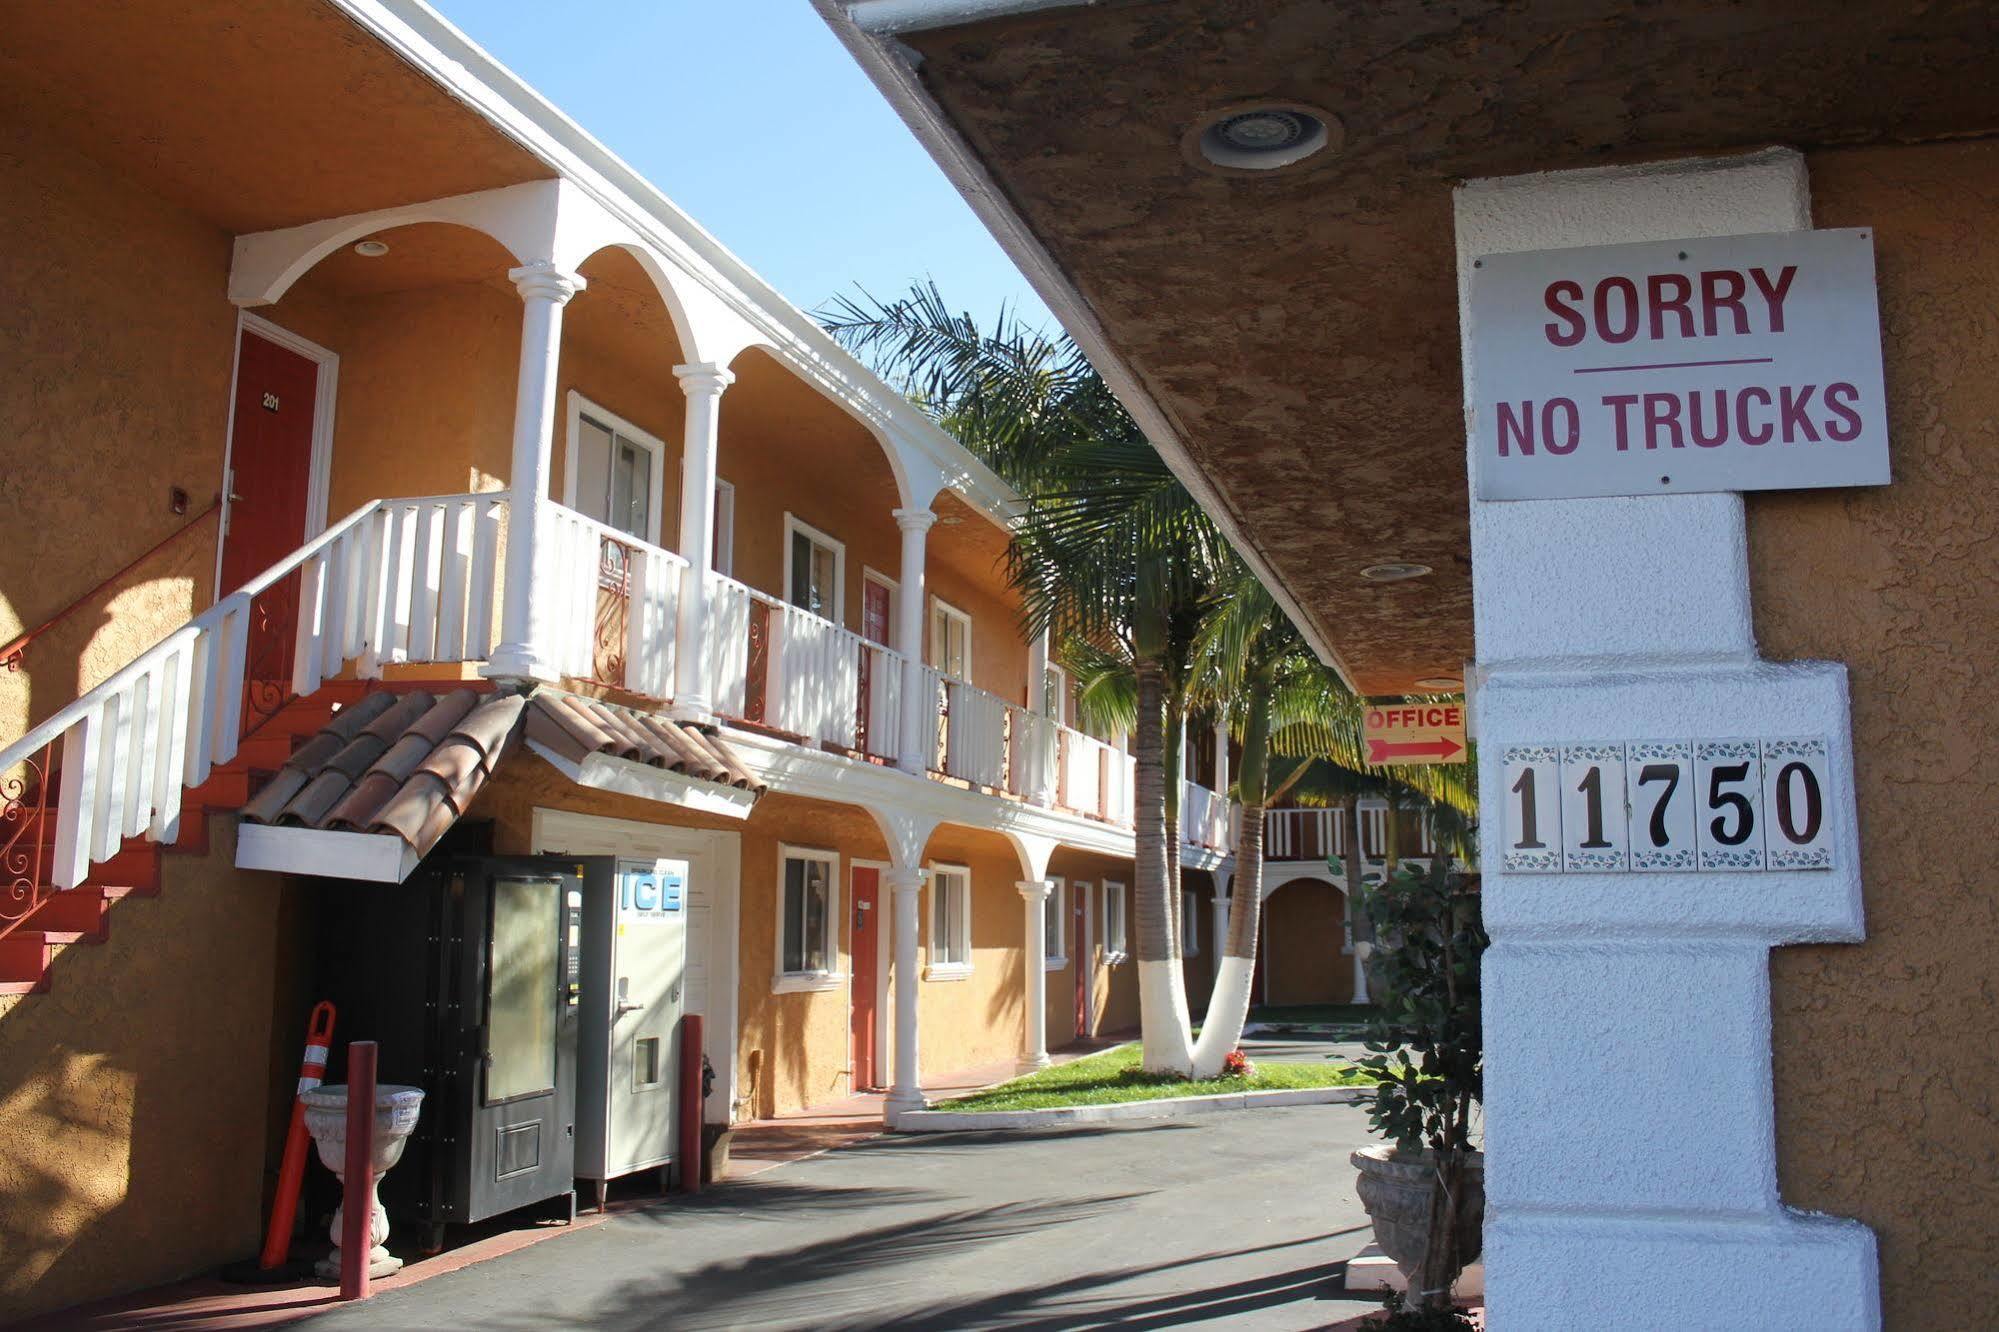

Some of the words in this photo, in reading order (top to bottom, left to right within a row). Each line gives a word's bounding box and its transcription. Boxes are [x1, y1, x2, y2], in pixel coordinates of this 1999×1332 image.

[1544, 265, 1798, 347] SORRY
[263, 393, 279, 411] 201
[1496, 396, 1580, 457] NO
[1602, 382, 1862, 451] TRUCKS
[1367, 708, 1460, 729] OFFICE
[1512, 762, 1822, 848] 11750
[622, 873, 680, 910] ICE
